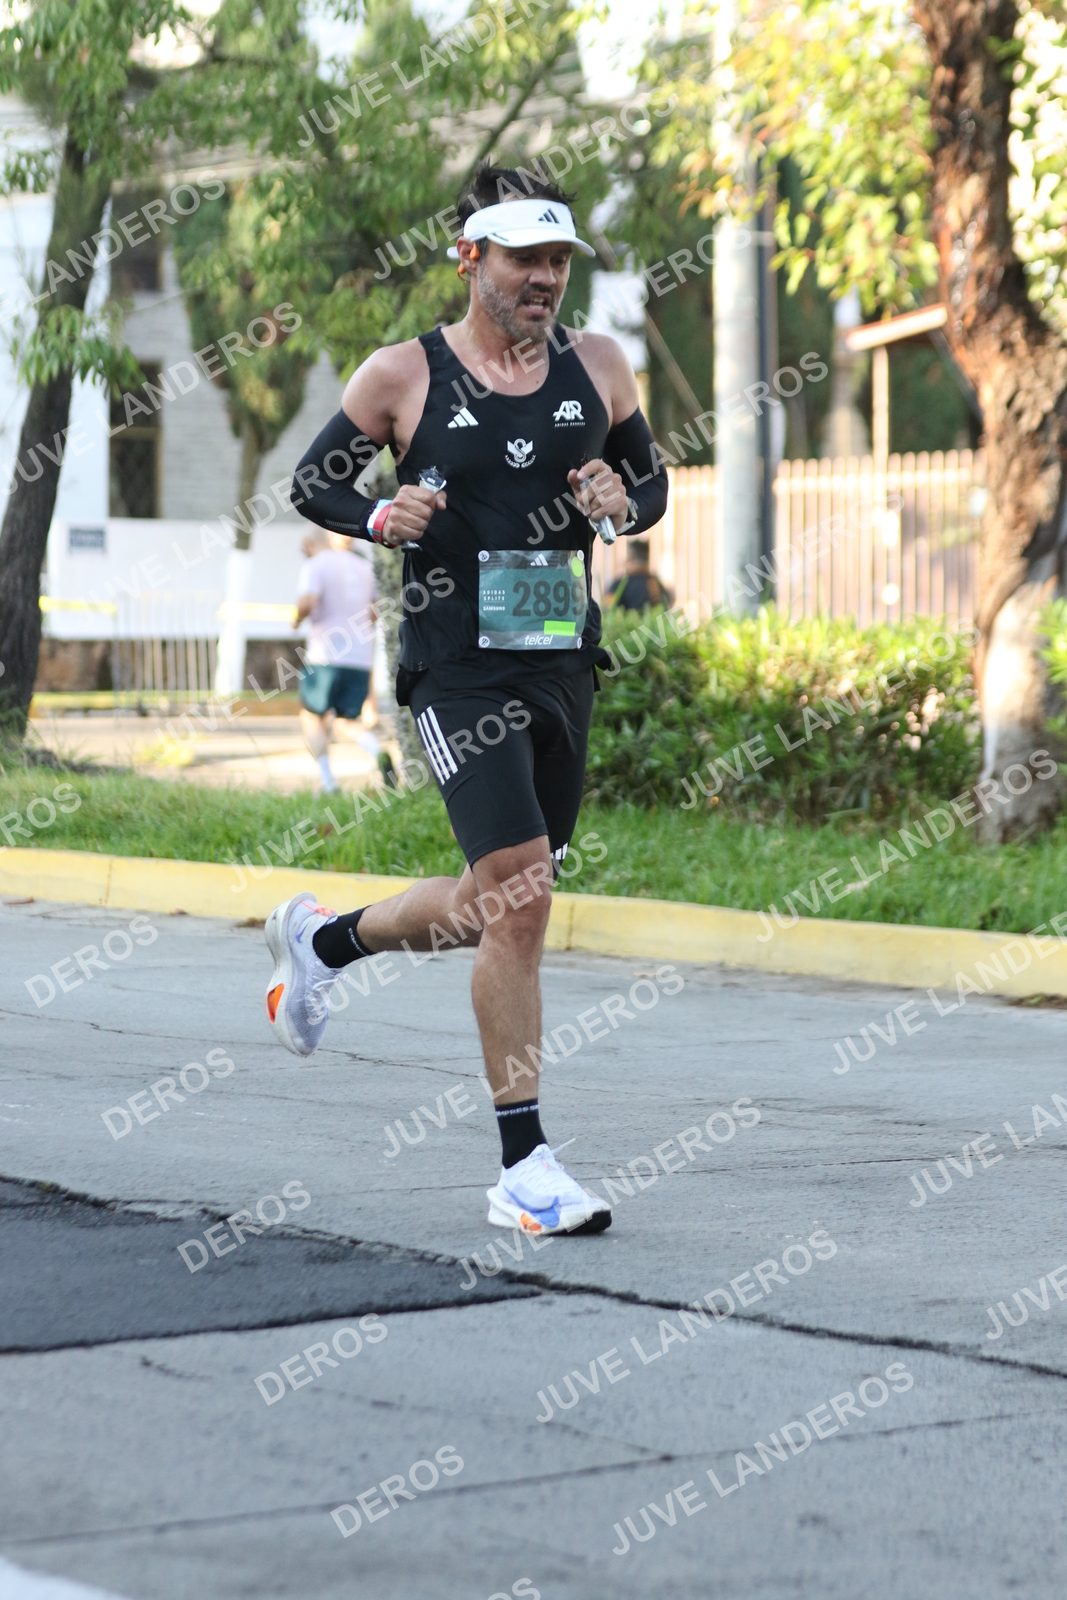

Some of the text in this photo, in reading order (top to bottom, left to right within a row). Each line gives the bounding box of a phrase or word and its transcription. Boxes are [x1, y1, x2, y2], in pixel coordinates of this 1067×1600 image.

[552, 400, 585, 421] AR
[512, 580, 585, 617] 2899
[524, 635, 553, 646] telcel
